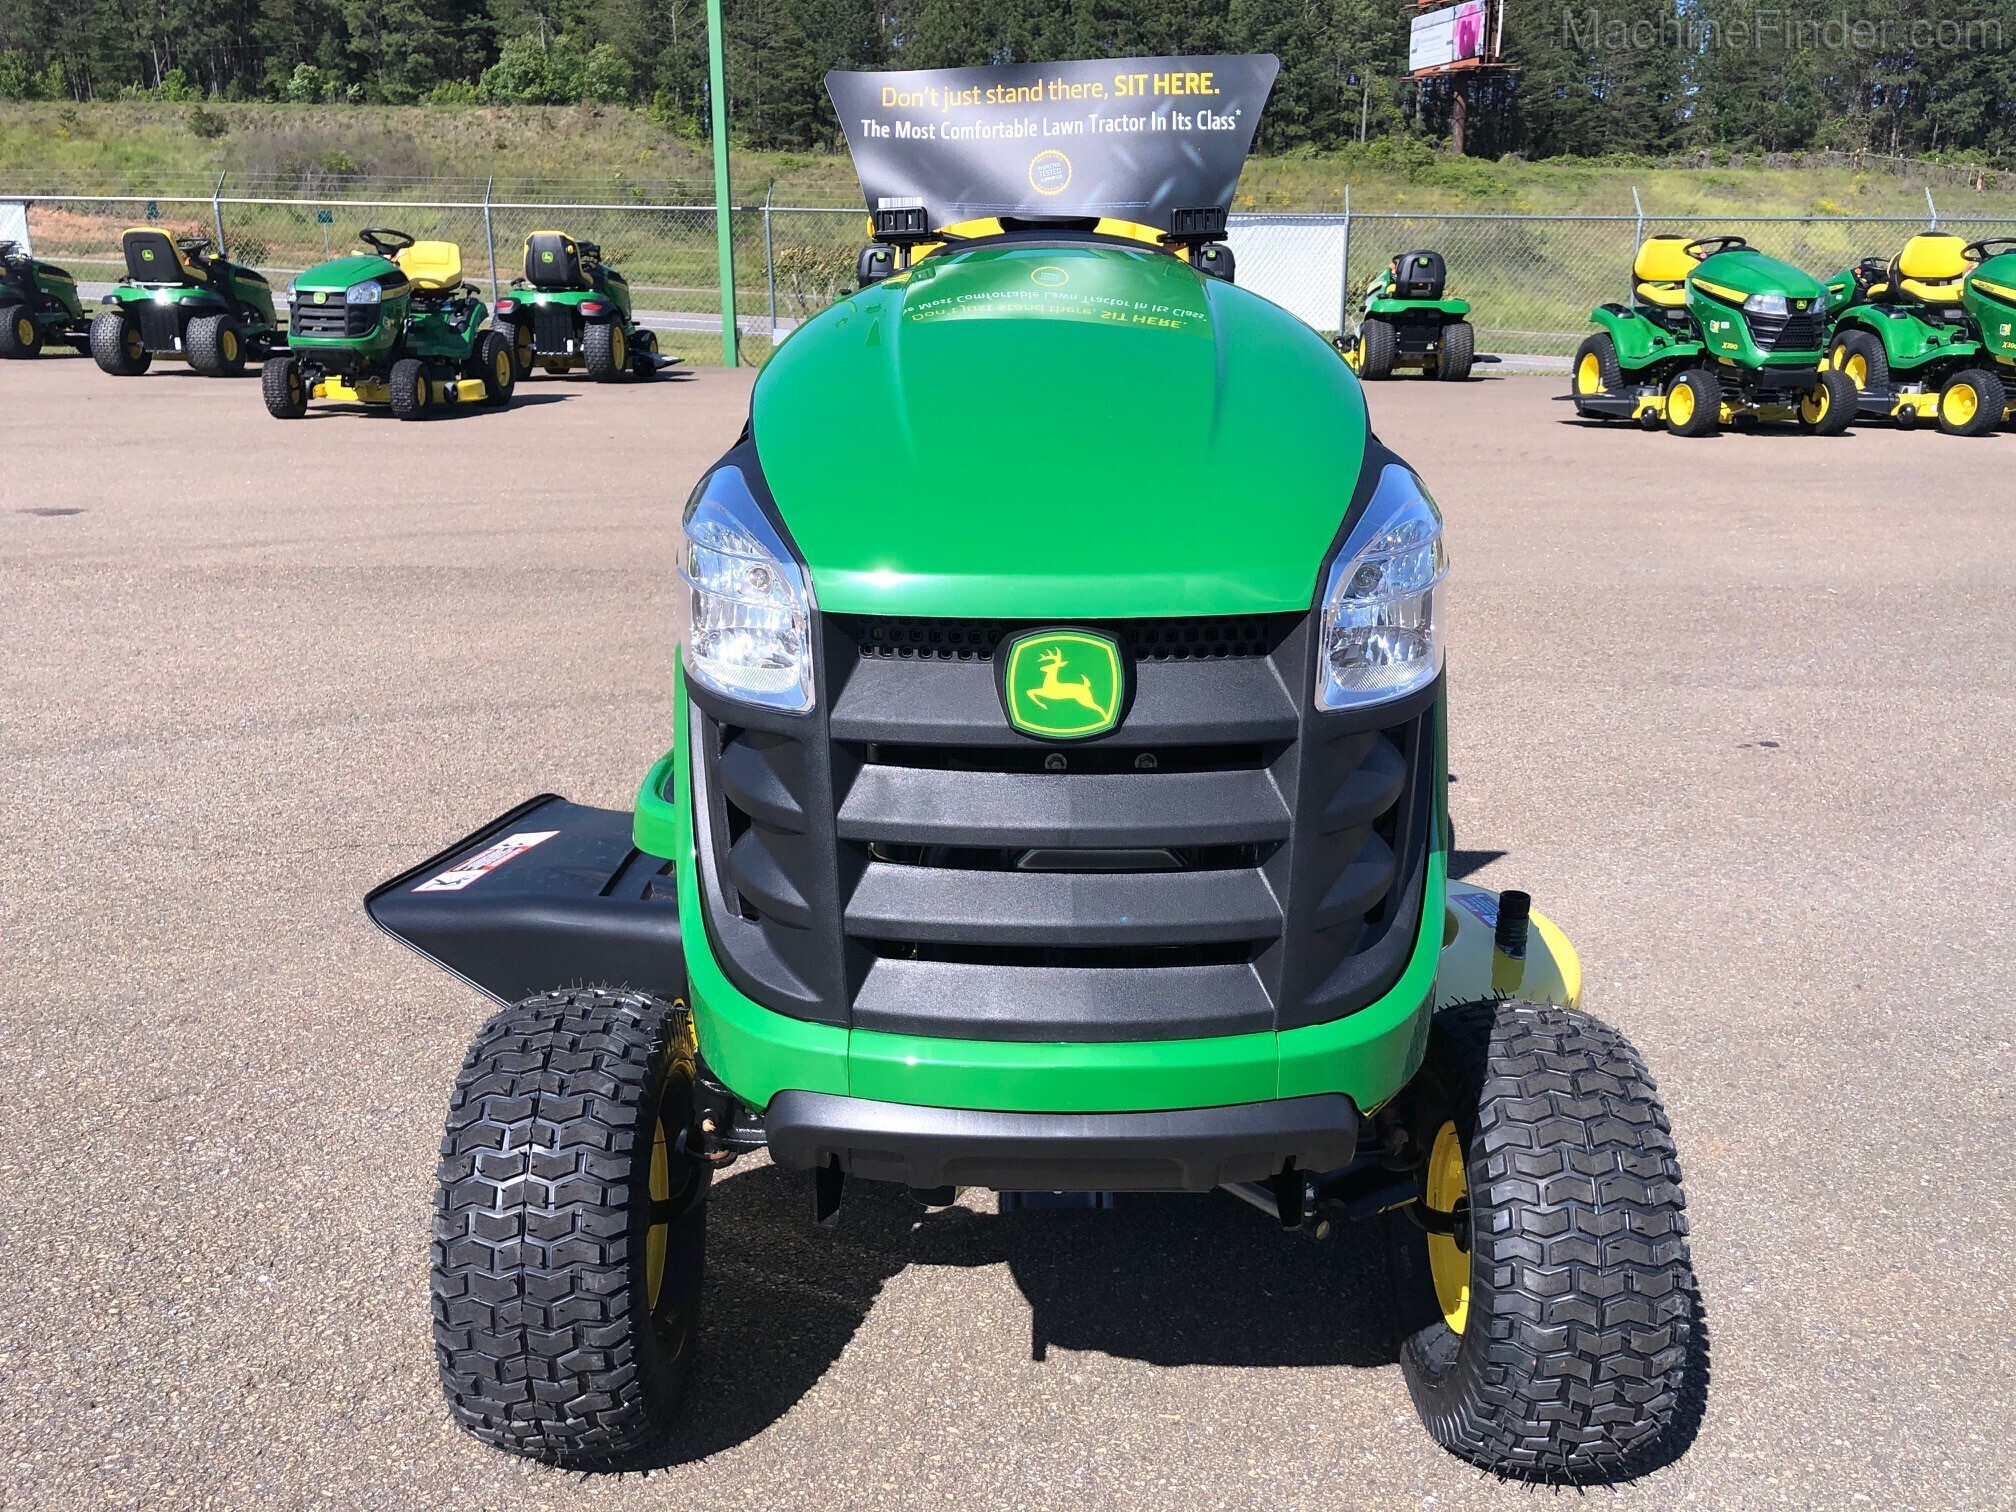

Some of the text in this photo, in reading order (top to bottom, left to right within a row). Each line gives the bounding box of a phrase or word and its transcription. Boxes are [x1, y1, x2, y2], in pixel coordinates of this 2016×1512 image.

[882, 72, 1220, 113] Don't just stand there, SIT HERE.
[861, 119, 890, 138] The
[895, 120, 936, 140] Most
[940, 117, 1038, 140] Comfortable
[1042, 117, 1084, 136] Lawn
[1088, 113, 1146, 134] Tractor
[1151, 110, 1167, 131] In
[1172, 109, 1192, 131] Its
[1039, 168, 1062, 177] TESTED
